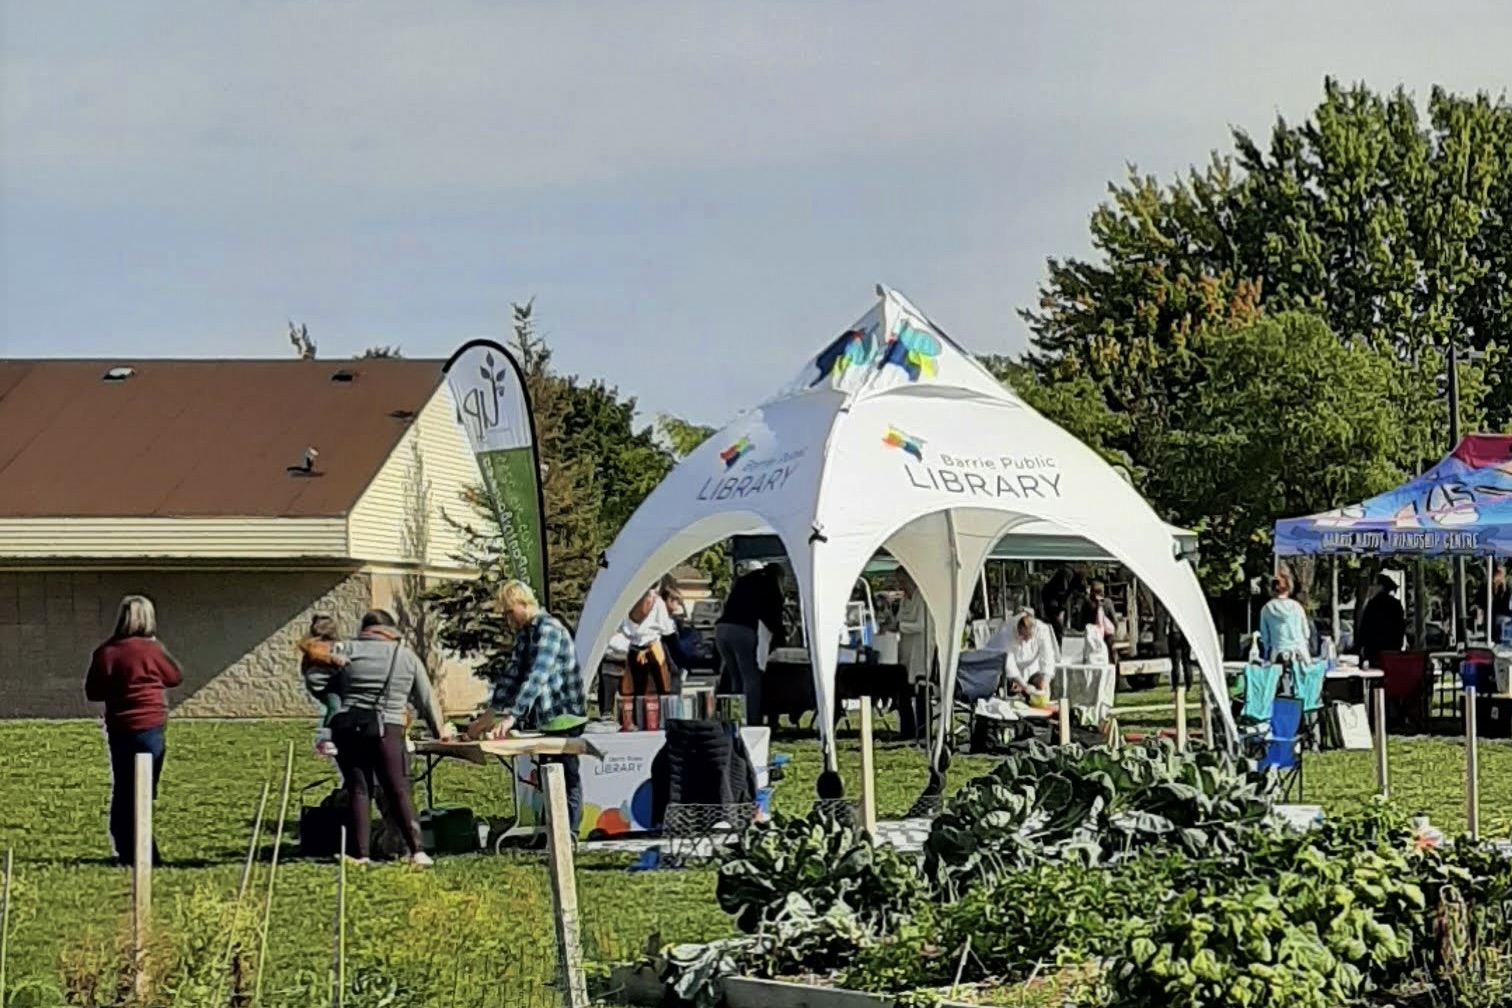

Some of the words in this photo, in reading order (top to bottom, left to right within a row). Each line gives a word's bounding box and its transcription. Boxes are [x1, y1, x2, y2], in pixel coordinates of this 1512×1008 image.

[940, 453, 997, 470] Barrie
[999, 456, 1056, 470] Public
[695, 464, 801, 501] LIBRARY
[904, 464, 1061, 498] LIBRARY
